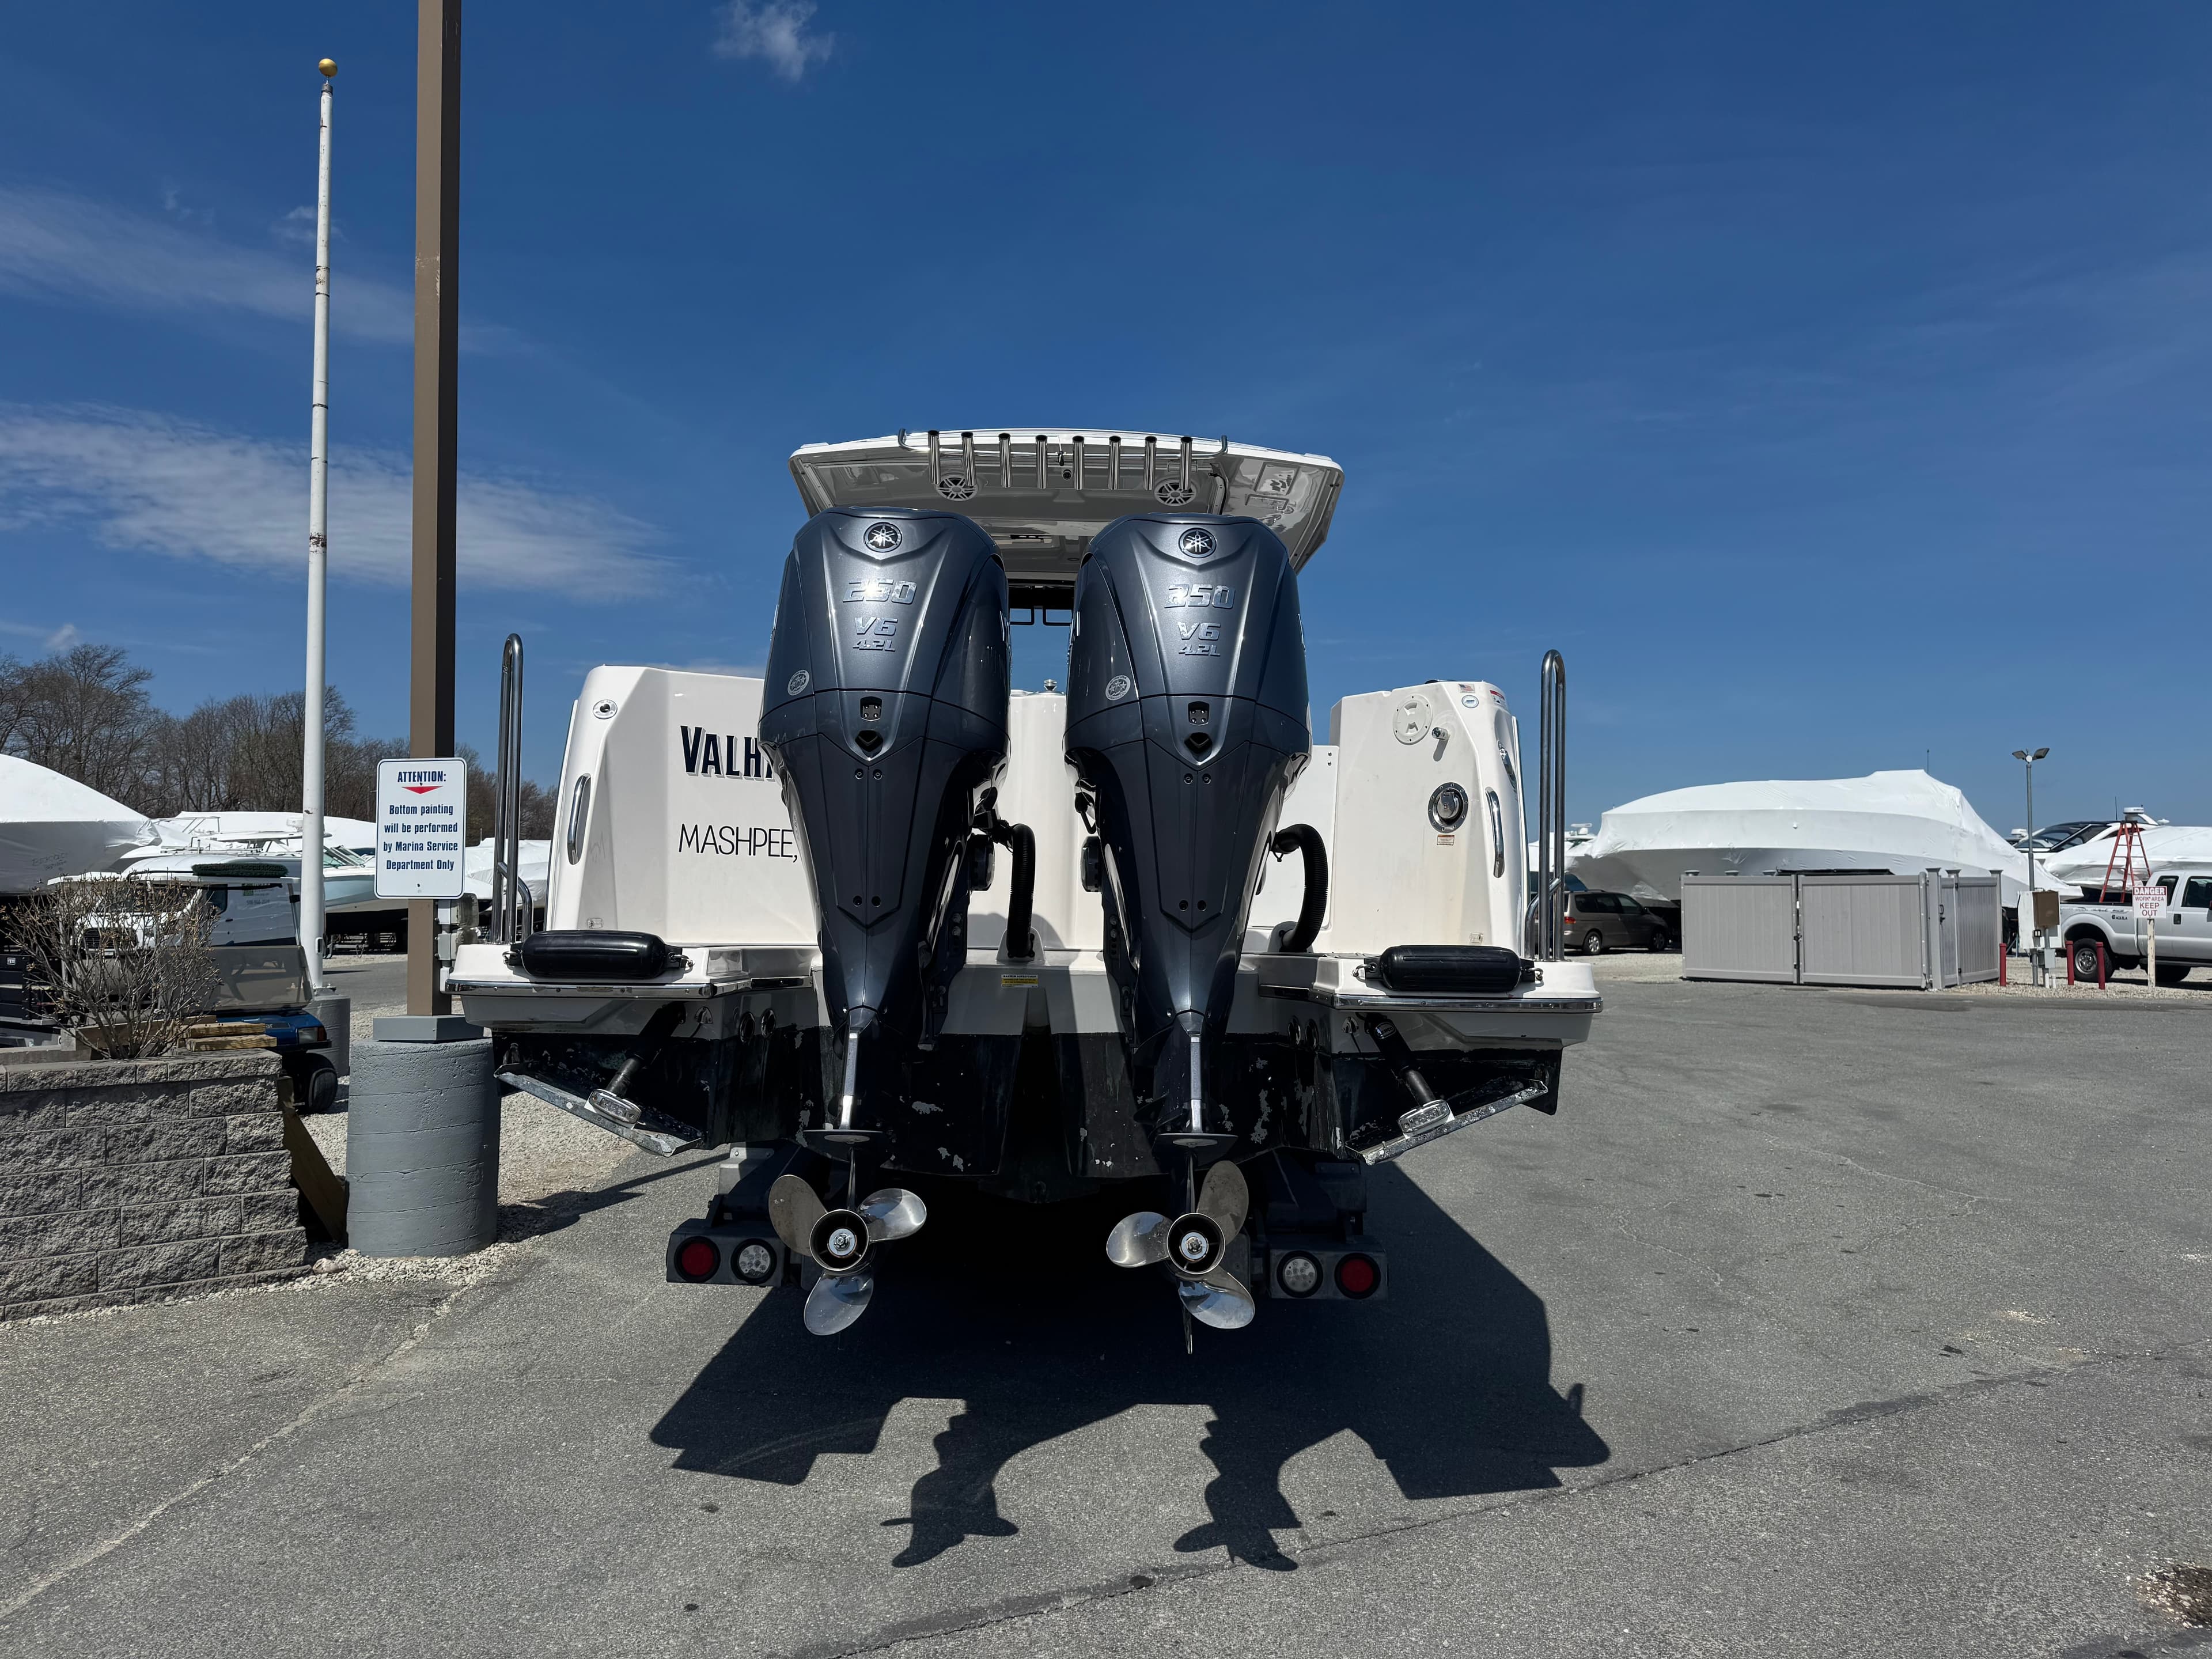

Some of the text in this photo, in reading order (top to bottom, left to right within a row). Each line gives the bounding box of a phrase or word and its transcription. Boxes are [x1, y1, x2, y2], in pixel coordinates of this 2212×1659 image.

[843, 578, 918, 605] 250
[1164, 584, 1236, 609] 250
[854, 616, 899, 637] V6
[1177, 622, 1221, 641] V6
[680, 725, 775, 781] VALH
[397, 771, 446, 782] ATTENTION:
[389, 804, 453, 816] Bottom painting
[384, 823, 457, 834] will be performed
[383, 841, 458, 853] by Marina Service
[679, 823, 798, 863] MASHPEE,
[387, 859, 454, 871] Department Only
